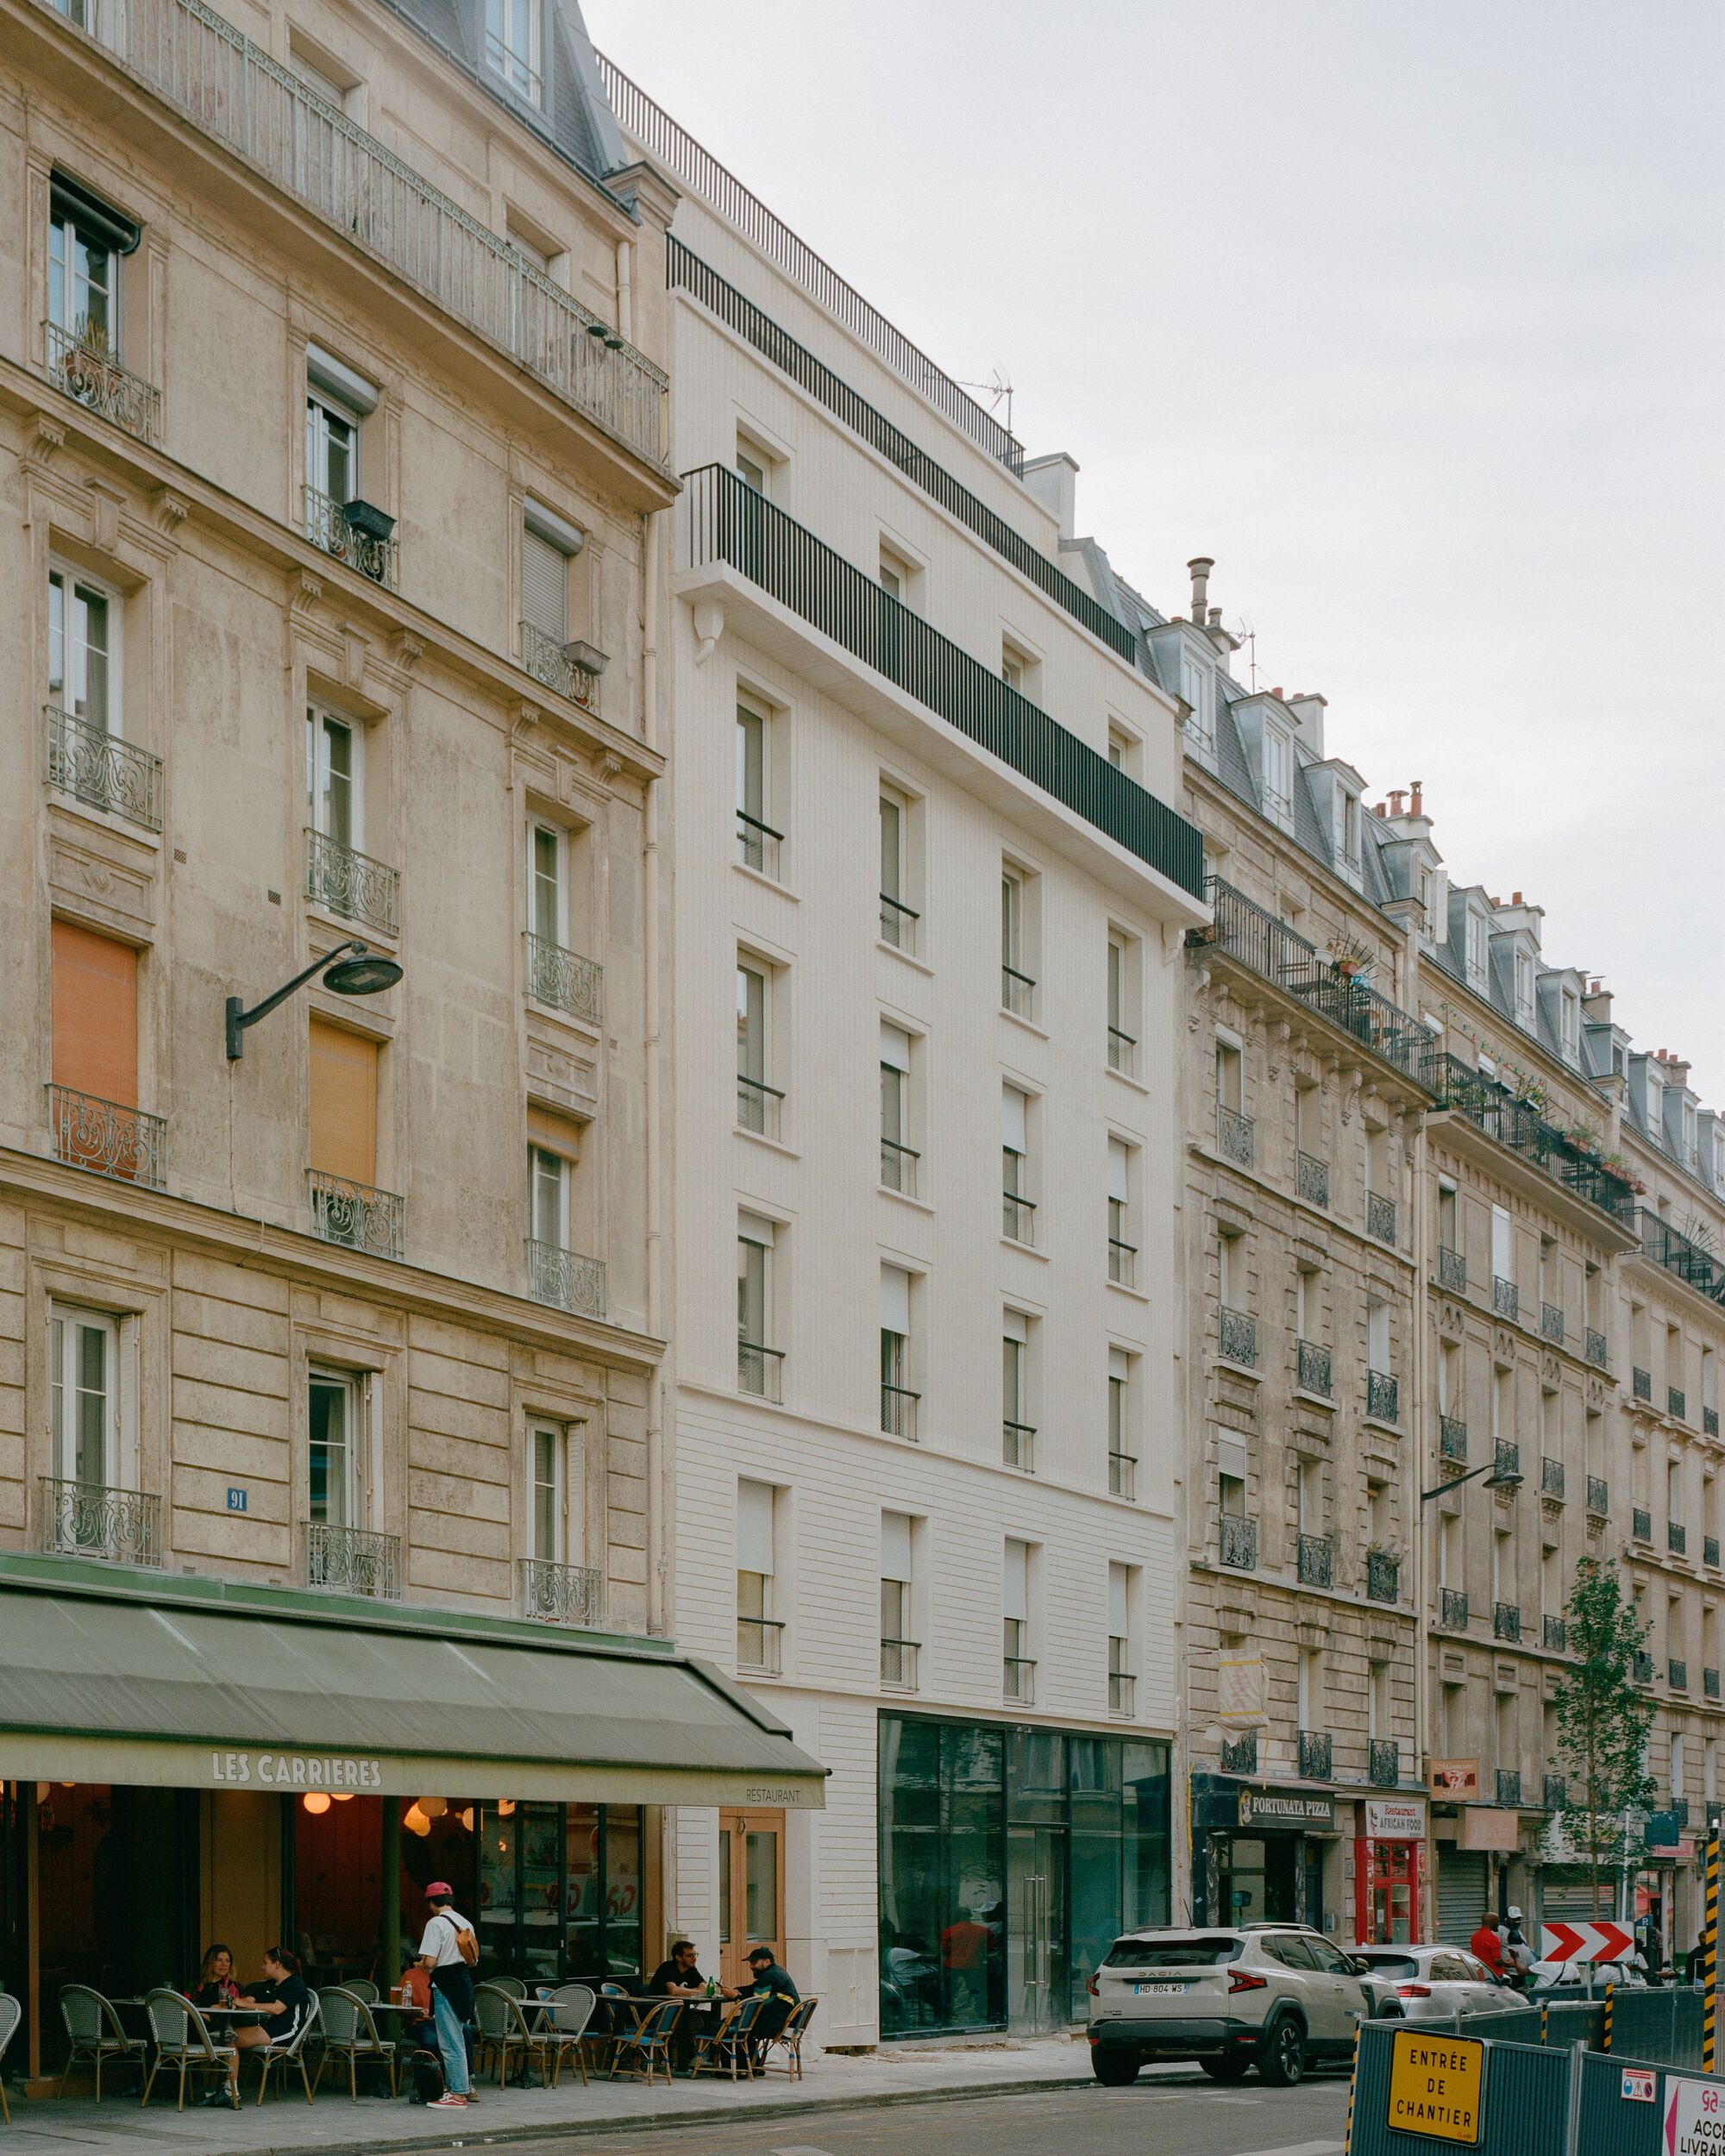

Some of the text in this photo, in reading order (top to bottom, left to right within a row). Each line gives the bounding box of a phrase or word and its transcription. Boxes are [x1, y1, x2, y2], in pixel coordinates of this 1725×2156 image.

[231, 1491, 243, 1509] 91
[212, 1752, 383, 1787] LES CARRIERES
[746, 1789, 801, 1802] RESTAURANT
[1252, 1796, 1331, 1817] FORTUNATA PIZZA
[1384, 1804, 1416, 1816] Restaurant
[1380, 1817, 1406, 1829] AFRICAN
[1407, 1818, 1421, 1831] FOOD
[1410, 2049, 1467, 2071] ENTRÉE
[1427, 2078, 1445, 2095] DE
[1396, 2099, 1471, 2128] CHANTIER
